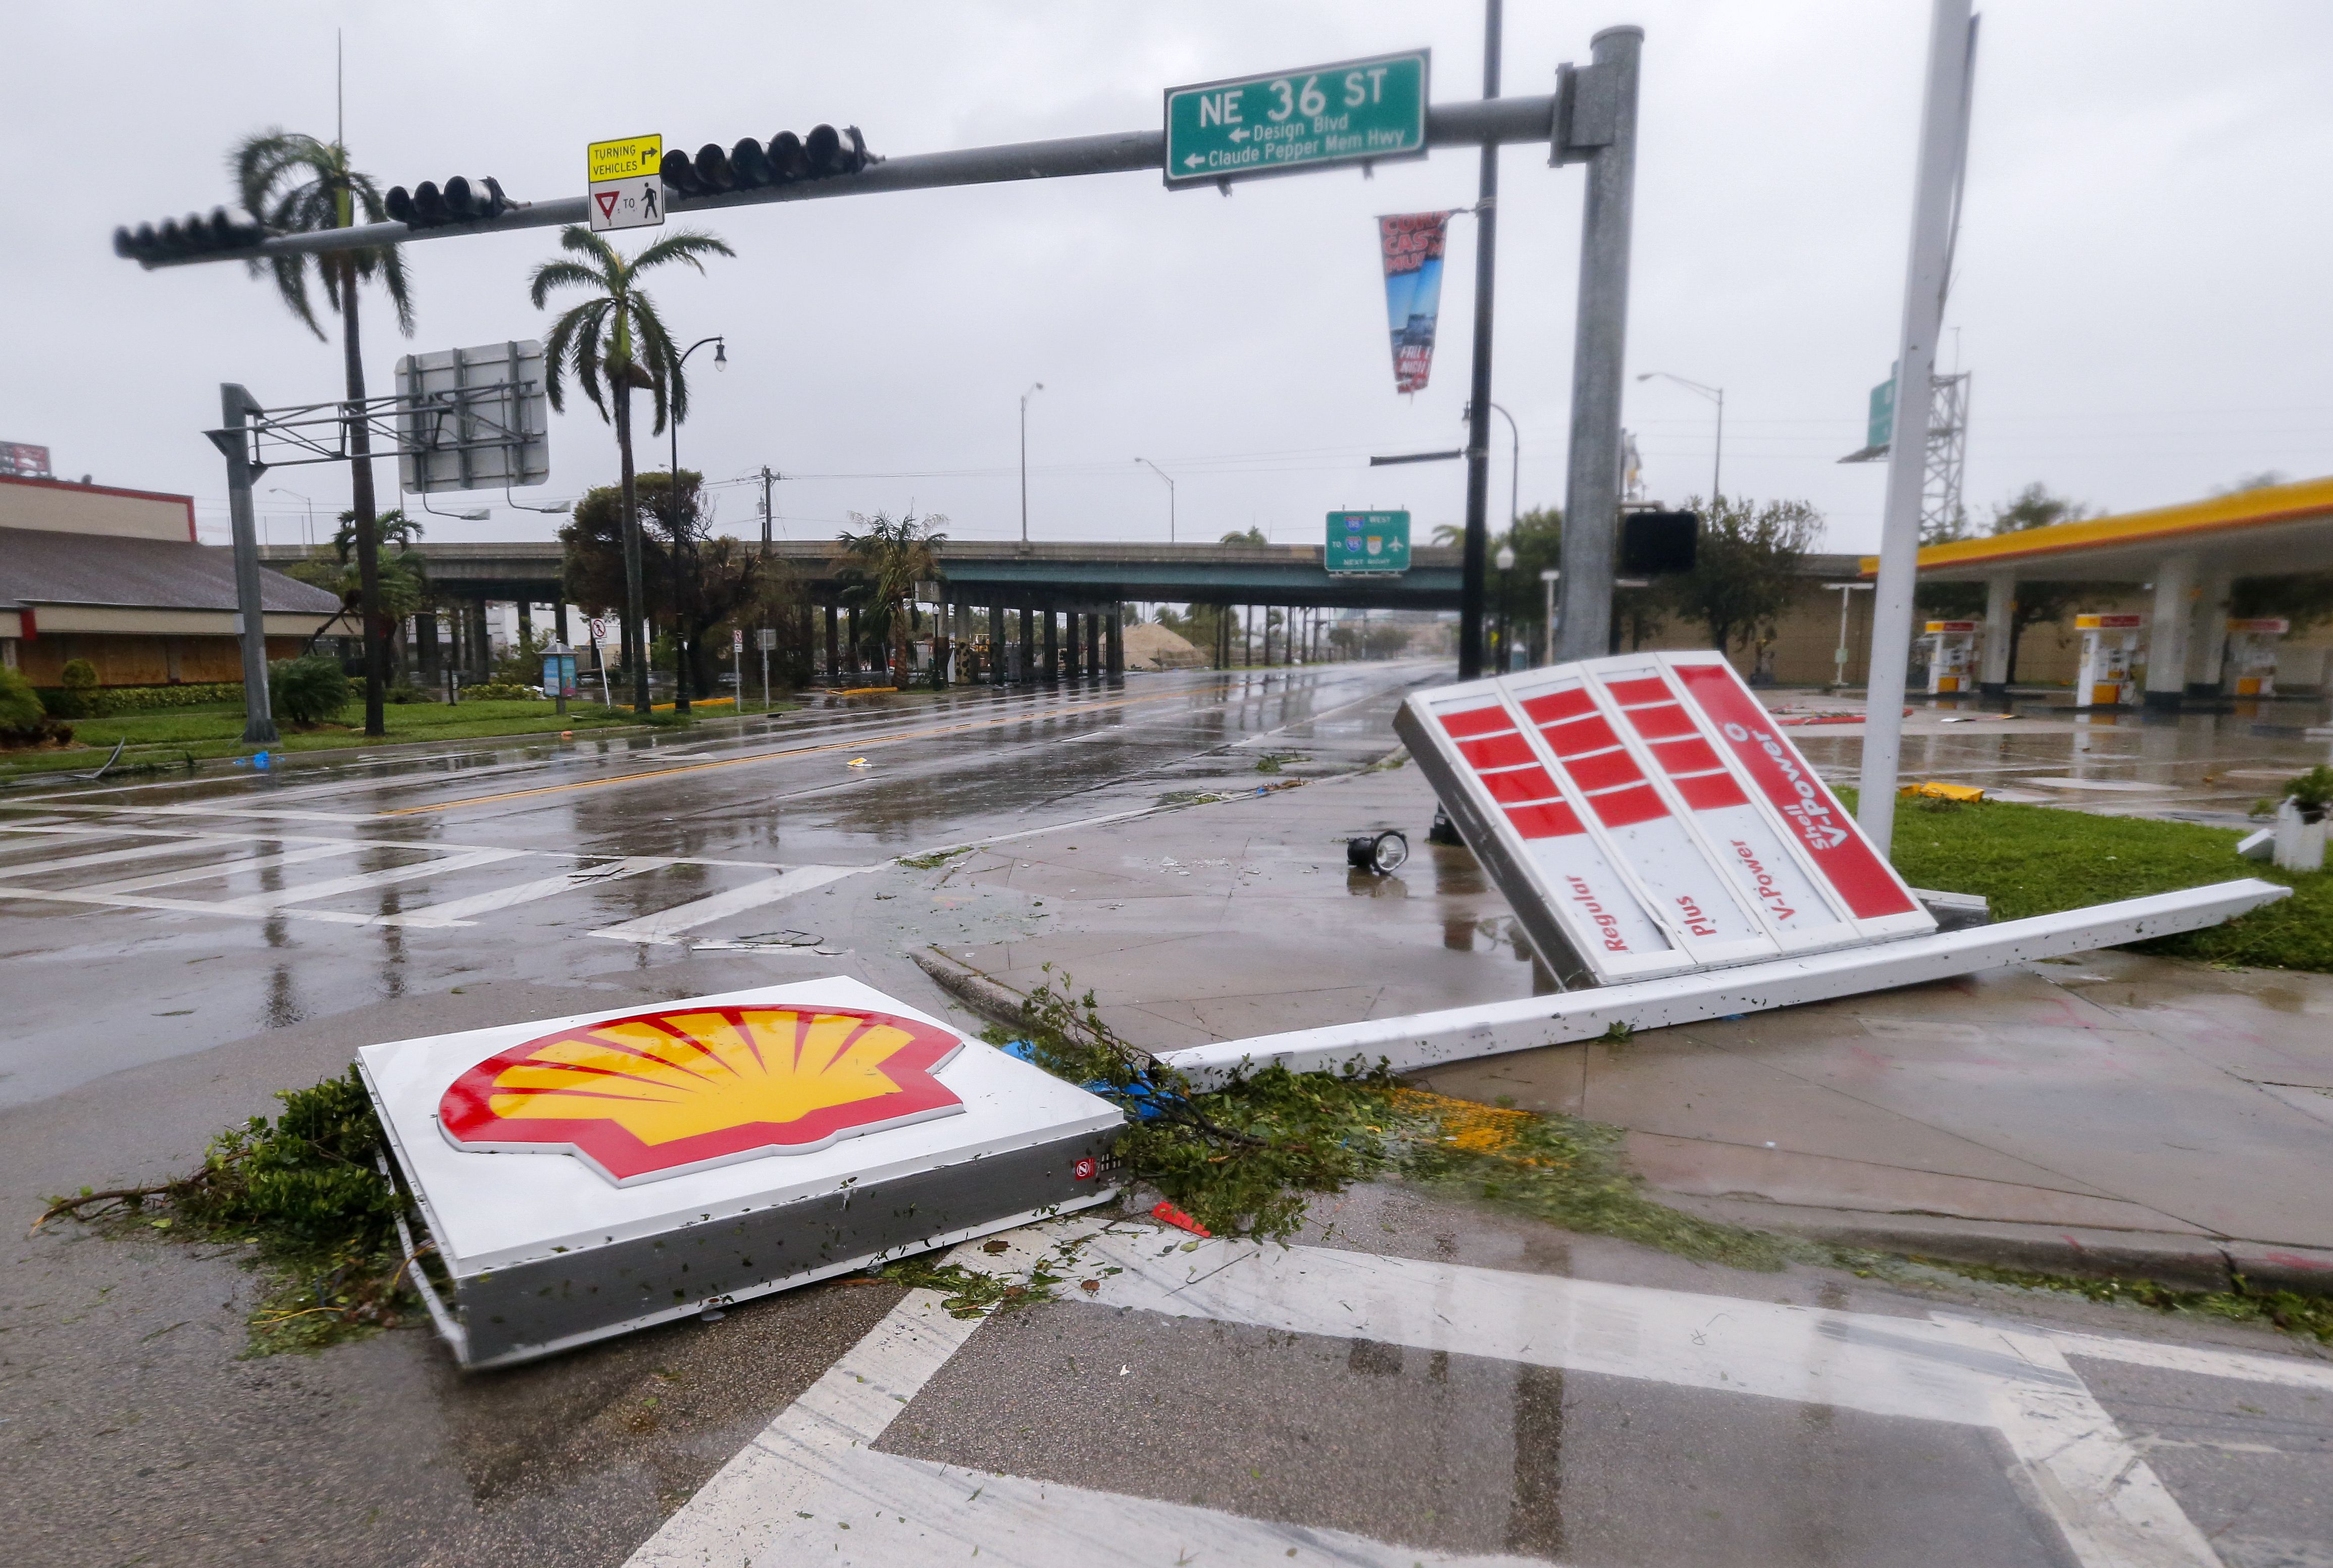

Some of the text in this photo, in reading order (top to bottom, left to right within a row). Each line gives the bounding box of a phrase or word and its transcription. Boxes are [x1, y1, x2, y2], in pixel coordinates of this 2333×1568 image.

[1200, 68, 1387, 127] NE 36 ST
[1209, 129, 1405, 167] Claude Pepper Mem Hwy
[1254, 113, 1349, 142] Design Blvd
[593, 161, 638, 175] VEHICLES
[594, 145, 636, 160] TURNING
[624, 198, 635, 208] TO
[1751, 729, 1848, 848] V-Power
[1783, 804, 1831, 851] Shell
[1730, 840, 1796, 920] V-Power
[1565, 875, 1629, 952] Regular
[1676, 896, 1717, 937] Plus
